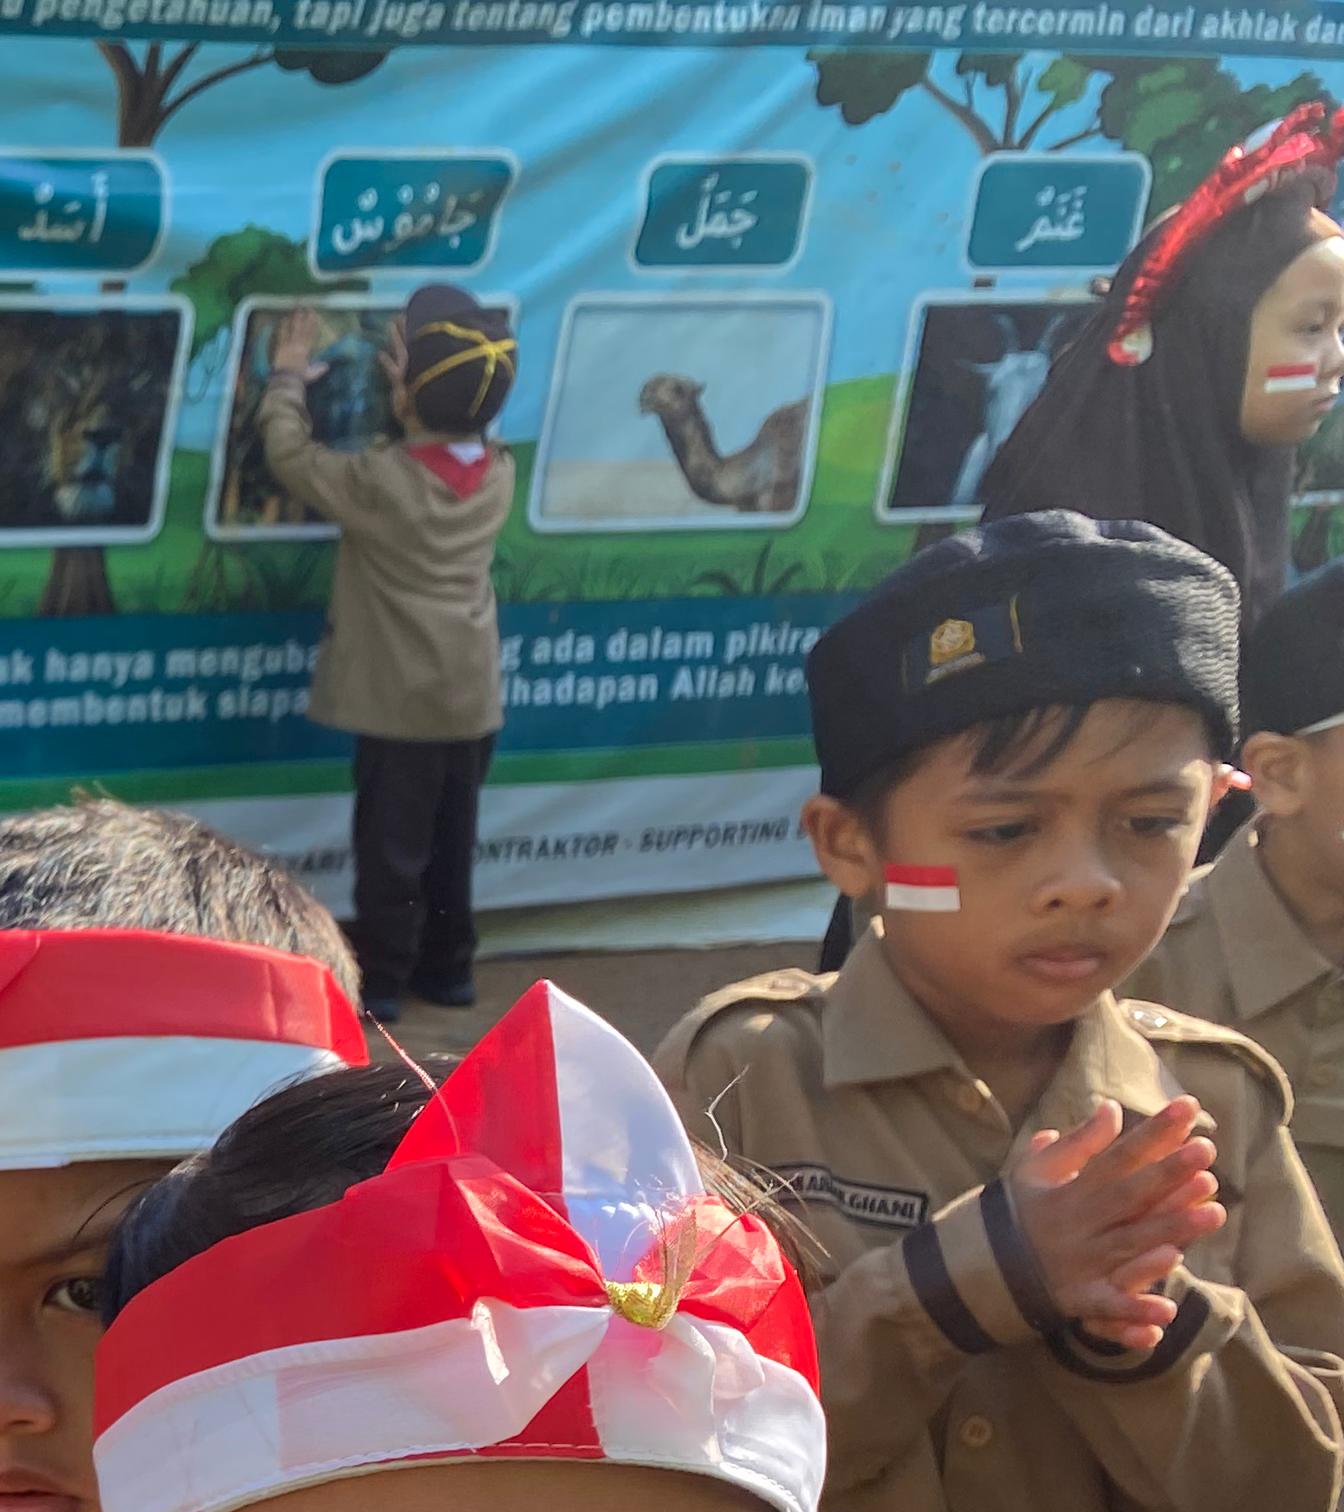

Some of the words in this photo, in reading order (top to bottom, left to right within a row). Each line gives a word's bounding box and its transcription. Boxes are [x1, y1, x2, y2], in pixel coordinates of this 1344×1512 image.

[886, 5, 967, 40] yang
[972, 2, 1125, 37] tercermin
[1133, 5, 1195, 38] dari
[1200, 8, 1298, 41] akhlak
[45, 646, 154, 687] hanya
[166, 635, 320, 682] menguba
[530, 629, 596, 665] ada
[605, 626, 716, 662] dalam
[723, 621, 825, 663] pikira
[670, 664, 756, 701] Allah
[475, 831, 619, 866] ONTRAKTOR
[640, 816, 788, 854] SUPPORTING
